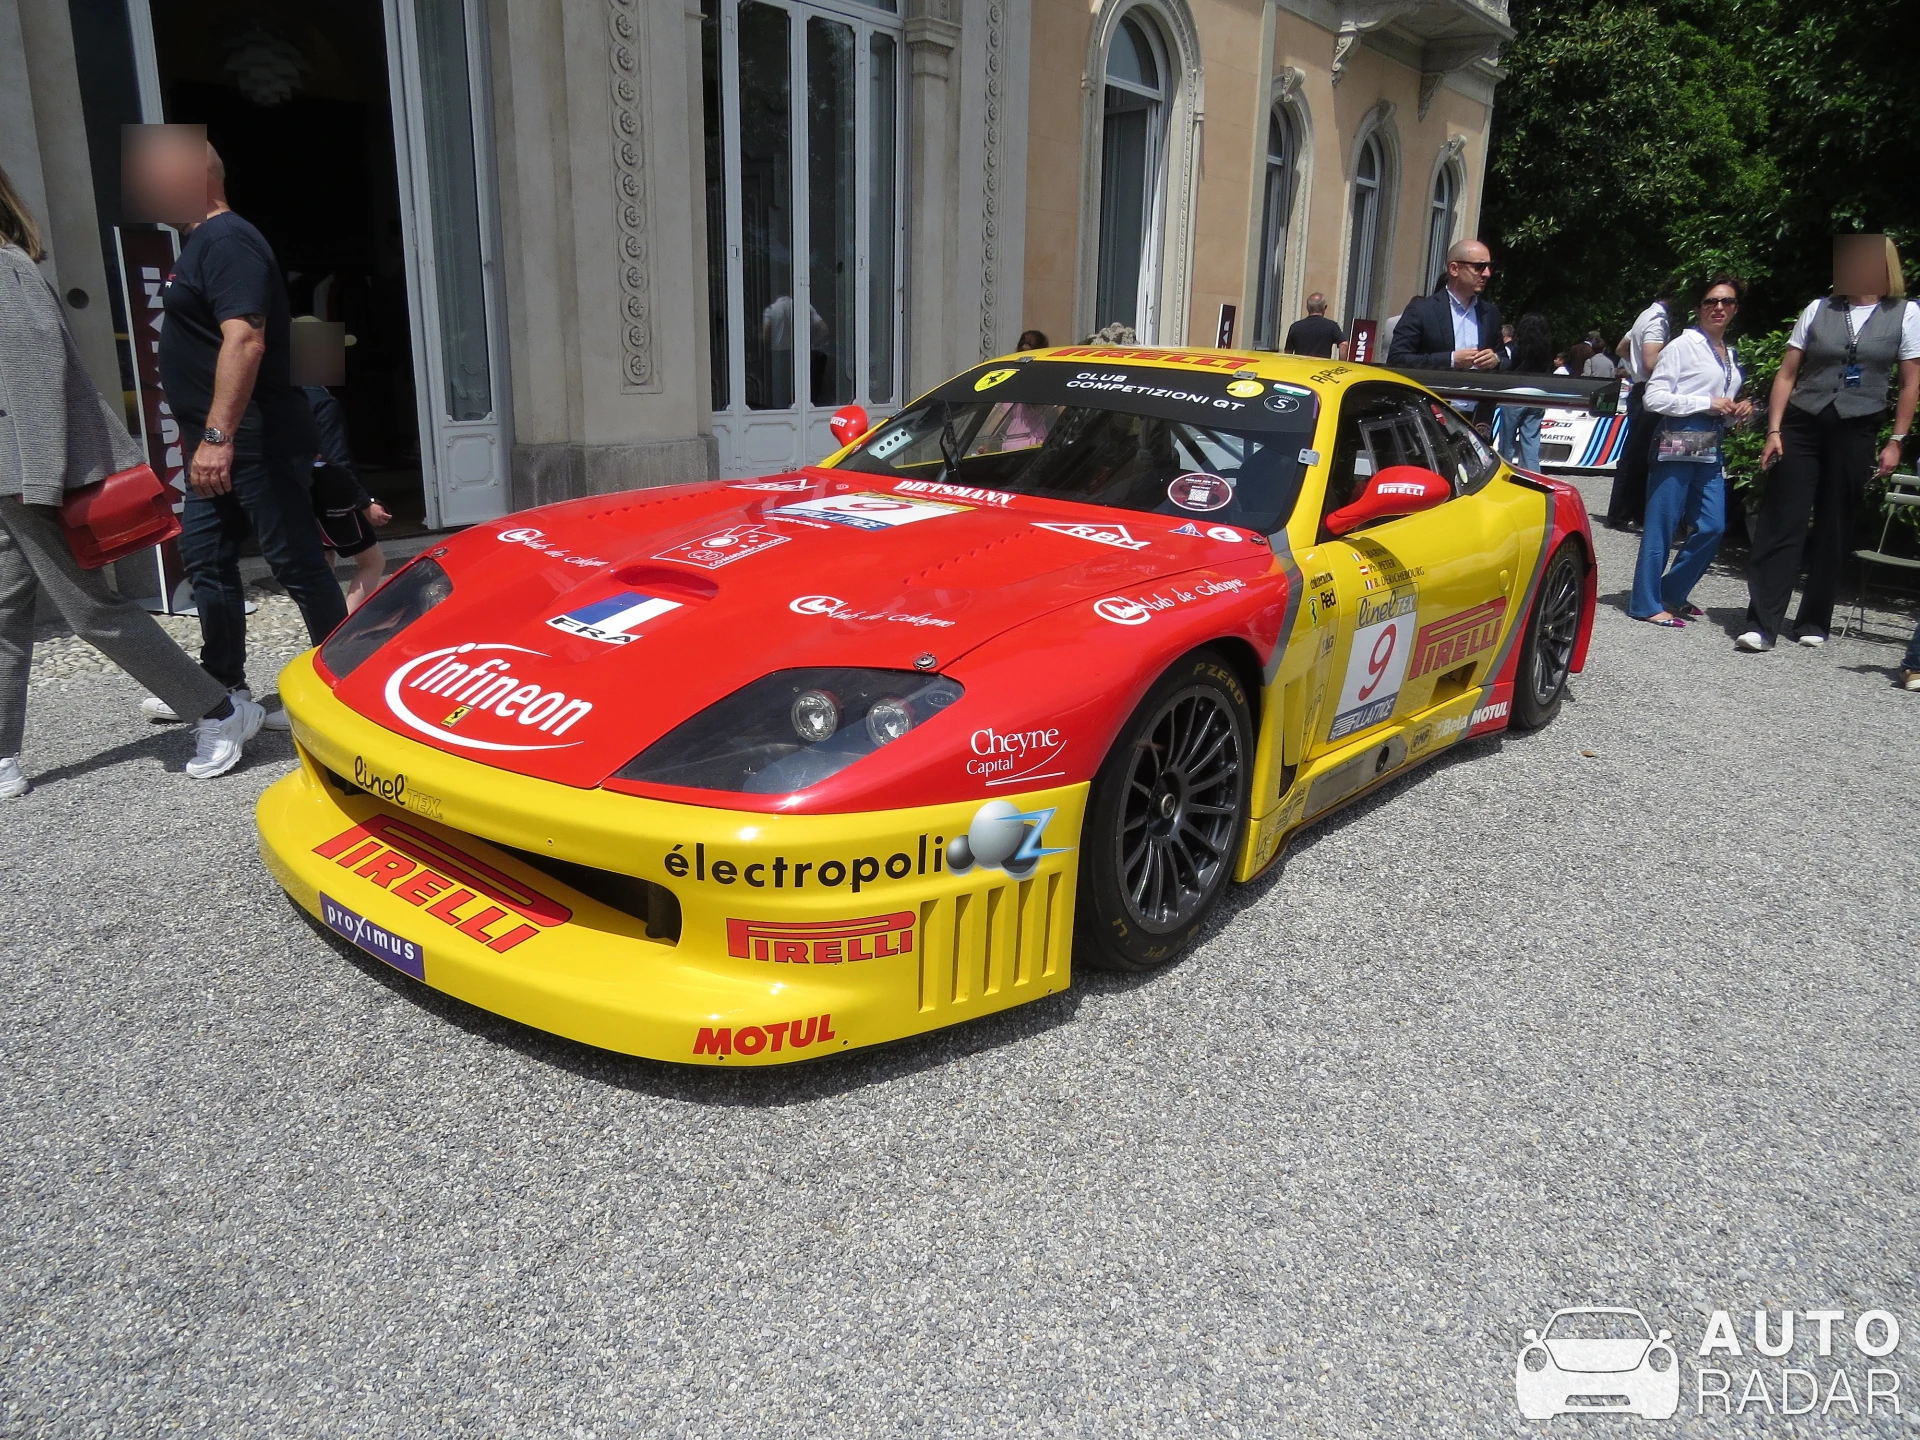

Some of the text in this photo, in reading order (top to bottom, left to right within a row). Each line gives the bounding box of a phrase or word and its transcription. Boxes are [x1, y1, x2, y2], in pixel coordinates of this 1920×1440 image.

[1046, 347, 1260, 369] PIRELLI
[1076, 372, 1128, 382] CLUB
[1065, 380, 1209, 404] COMPETIZIONI
[1212, 399, 1246, 411] GT
[1273, 399, 1289, 409] S
[893, 479, 1016, 504] DIETSMANN
[1377, 483, 1425, 496] PIRELLI
[1066, 526, 1151, 551] RBM
[1171, 588, 1197, 604] de
[1195, 577, 1247, 596] Cologne
[551, 616, 632, 644] FRA
[1408, 596, 1508, 681] PIRELLI
[1358, 623, 1398, 702] 9
[1205, 662, 1245, 705] ZERO
[1441, 701, 1509, 735] Beta MOTUL
[970, 728, 1060, 758] Cheyne
[354, 755, 406, 806] linel
[966, 754, 1014, 778] Capital
[664, 833, 944, 893] électropoli
[312, 814, 572, 954] PIRELLI
[727, 911, 916, 965] PIRELLI
[692, 1014, 836, 1056] MOTUL
